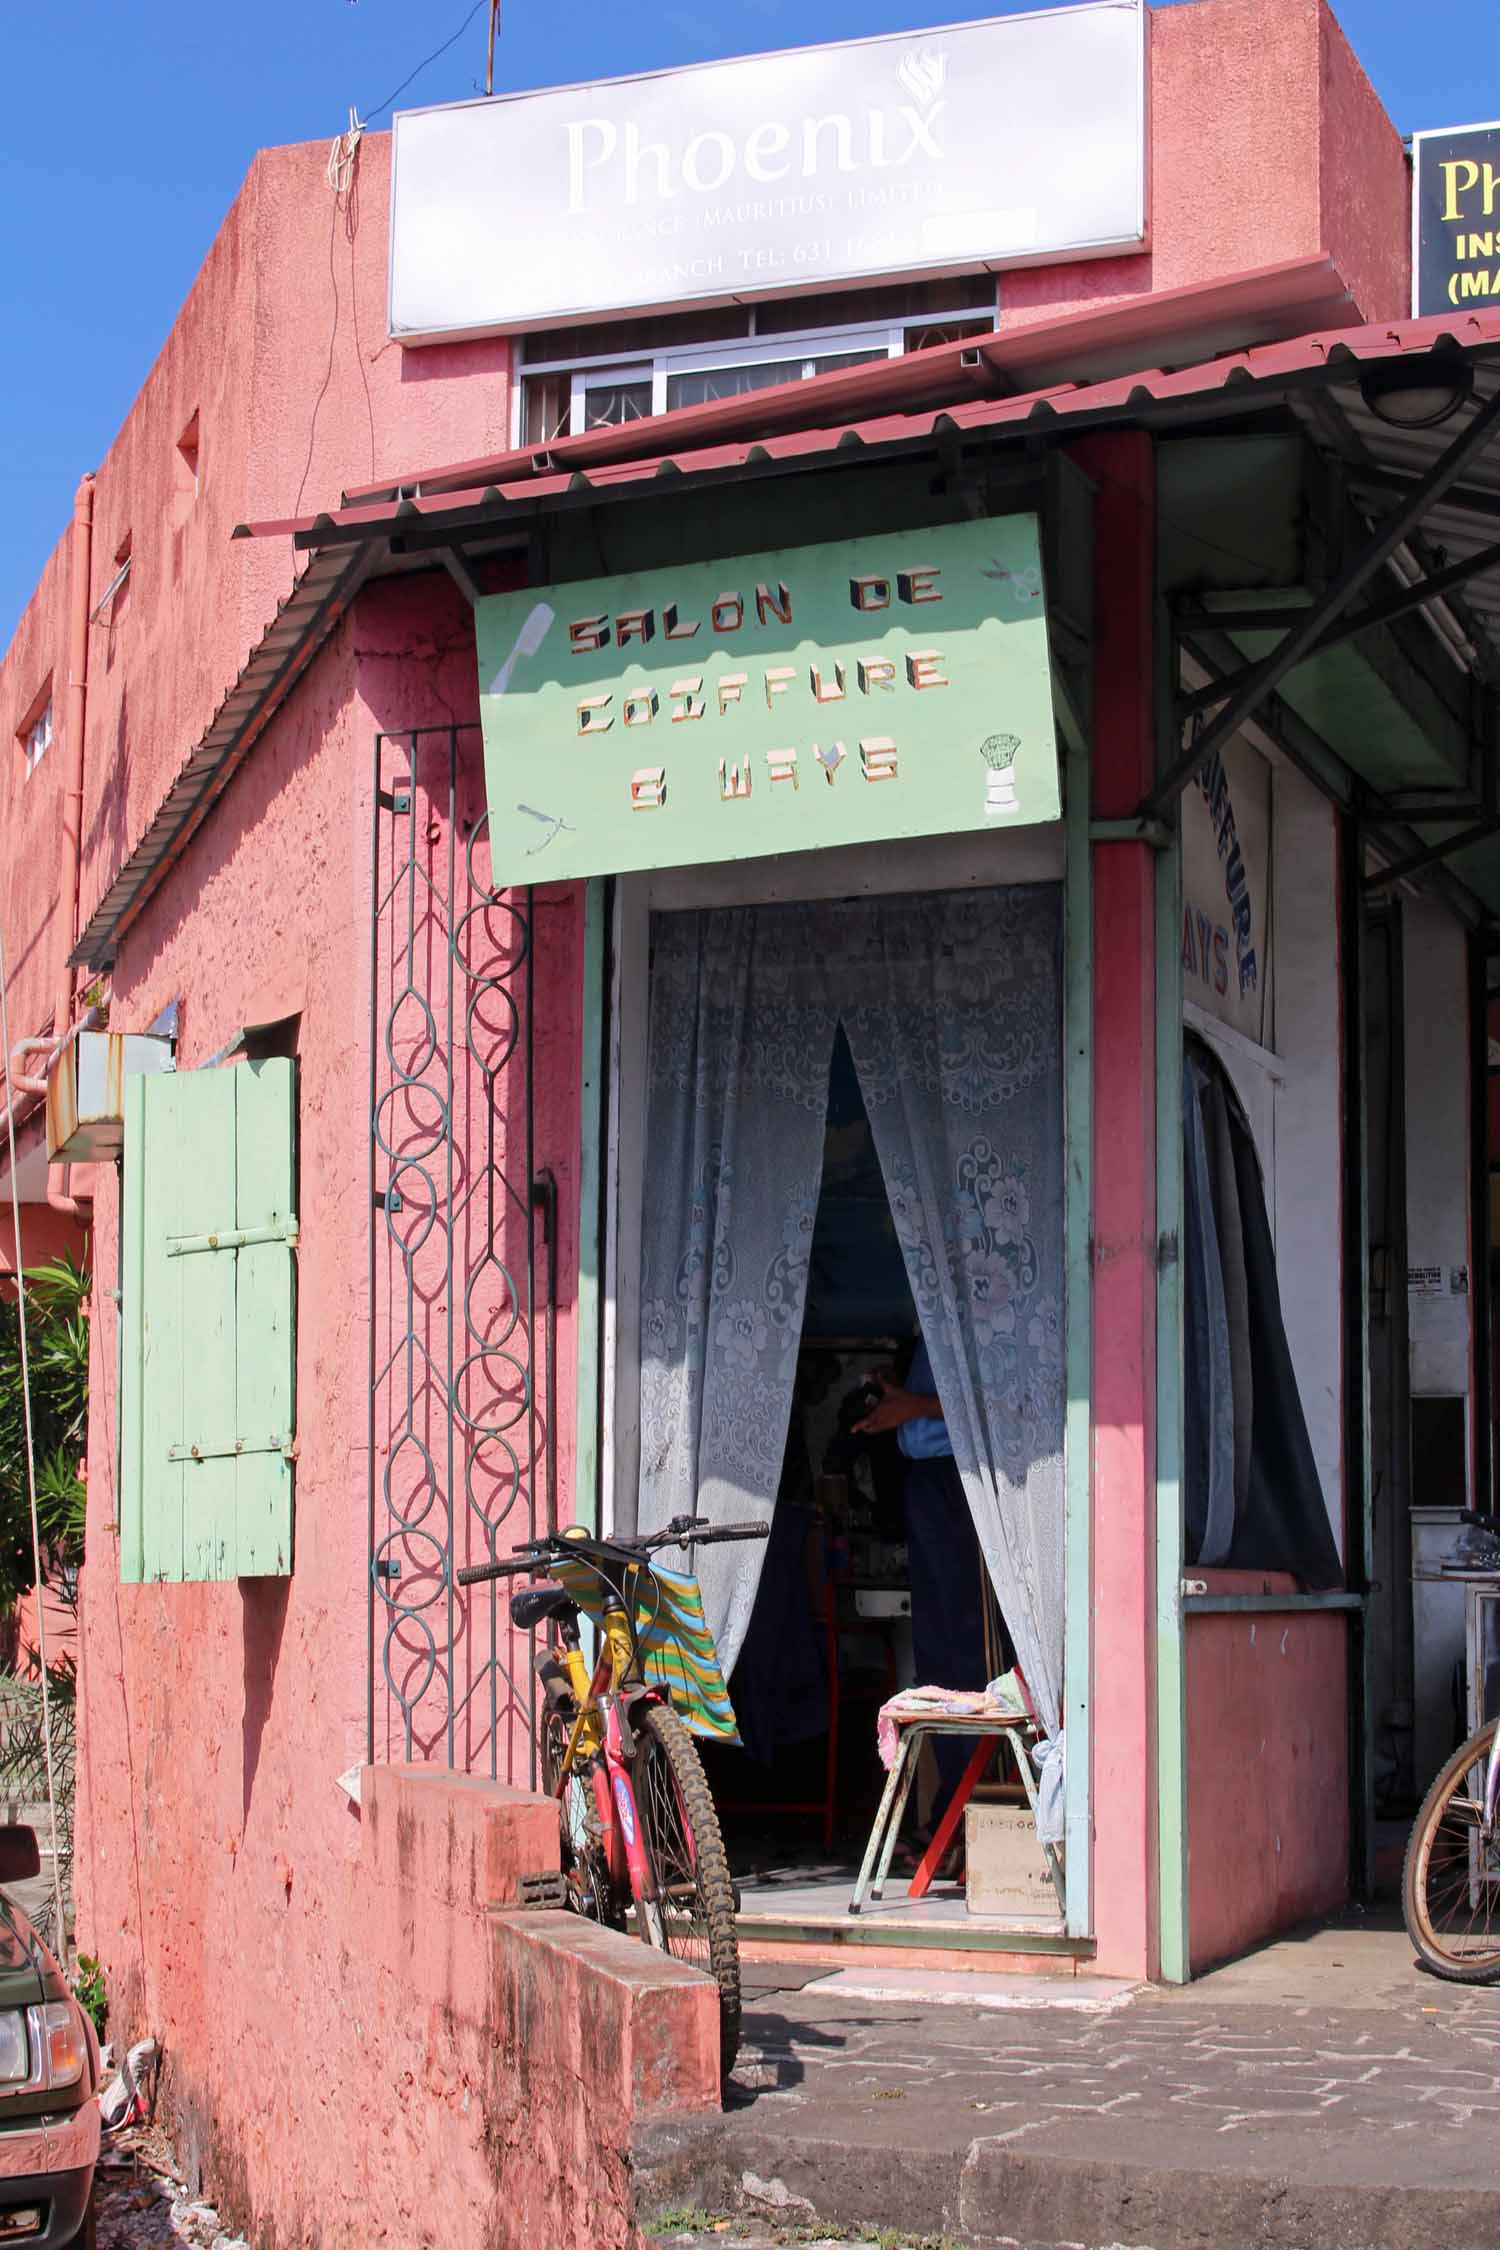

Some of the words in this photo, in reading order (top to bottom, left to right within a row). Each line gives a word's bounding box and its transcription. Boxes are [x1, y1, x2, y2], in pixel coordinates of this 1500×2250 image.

[563, 101, 946, 214] Phoenix
[793, 239, 832, 264] 631
[1456, 231, 1500, 261] IN
[569, 580, 794, 655] SALON
[849, 564, 944, 612] DE
[576, 650, 949, 737] COIFFURE
[718, 738, 899, 802] WAYS
